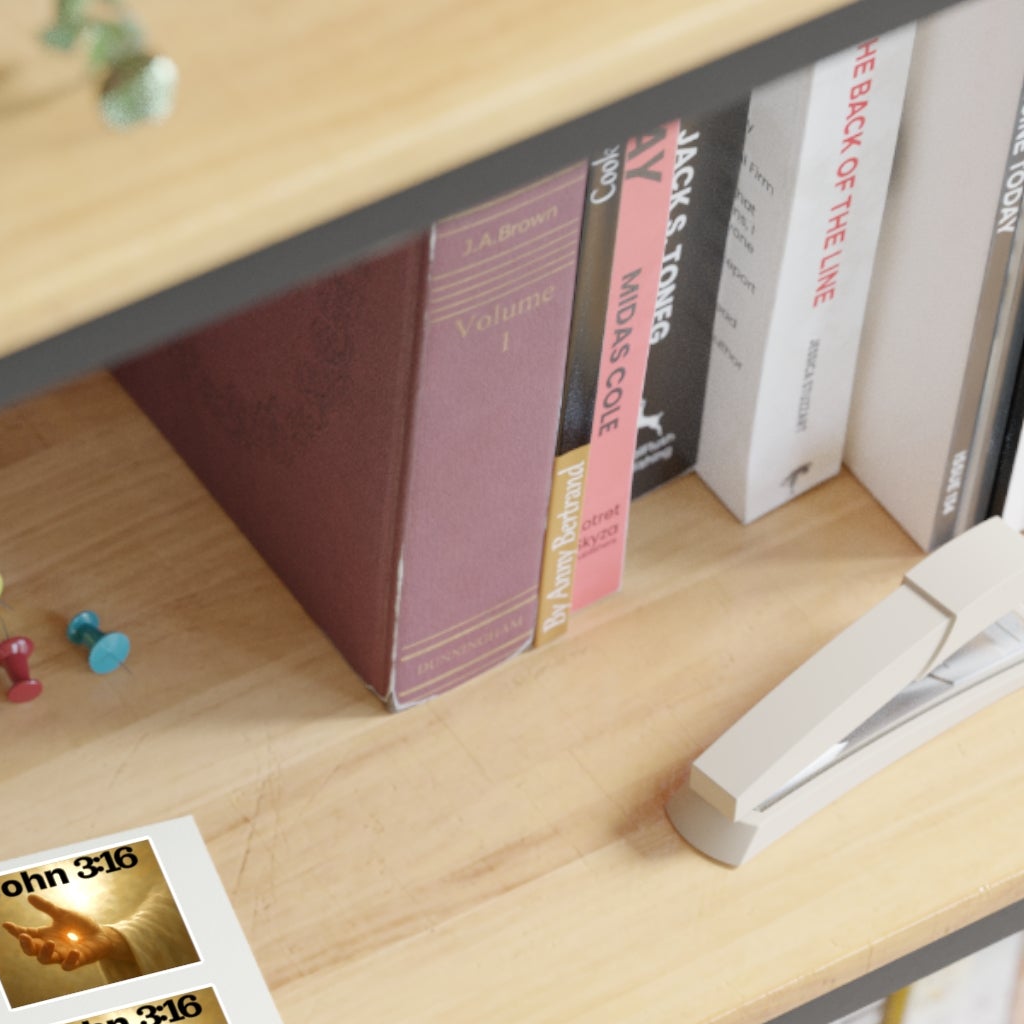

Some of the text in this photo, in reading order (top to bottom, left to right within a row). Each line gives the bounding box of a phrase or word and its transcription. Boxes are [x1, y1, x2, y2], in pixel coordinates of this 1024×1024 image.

[841, 79, 872, 155] BACK
[670, 129, 701, 211] JACK
[835, 156, 860, 192] OF
[996, 161, 1024, 234] TODAY
[823, 194, 853, 250] THE
[813, 250, 842, 308] LINE
[455, 285, 556, 338] Volume
[598, 267, 642, 437] MIDAS COLE
[551, 460, 585, 550] Bertrand
[542, 604, 573, 633] By
[73, 846, 139, 880] 3:16
